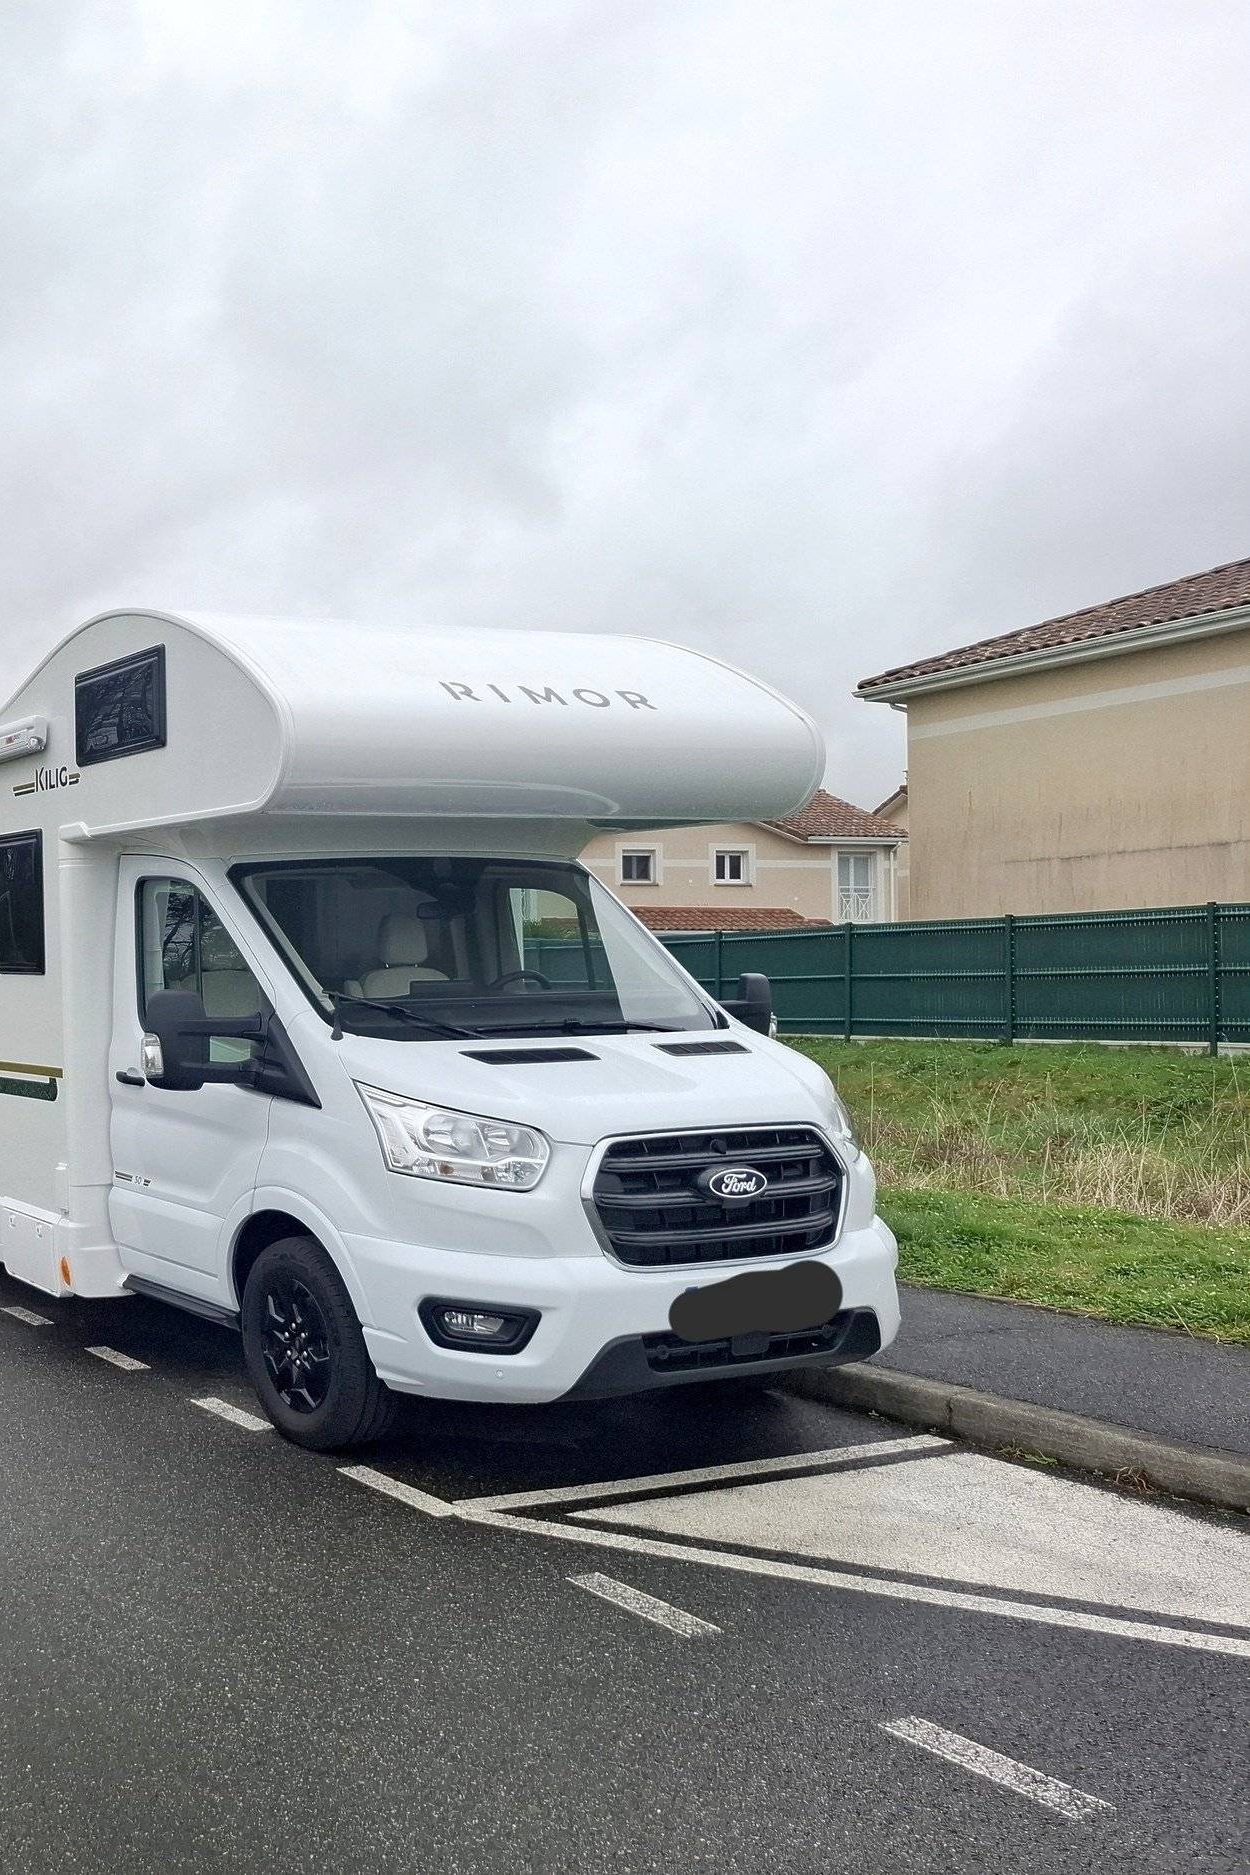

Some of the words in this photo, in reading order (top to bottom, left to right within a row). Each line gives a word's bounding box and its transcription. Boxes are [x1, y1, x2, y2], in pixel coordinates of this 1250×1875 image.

[437, 680, 658, 709] RIMOR
[35, 766, 68, 792] KILIG
[721, 1173, 757, 1194] Ford
